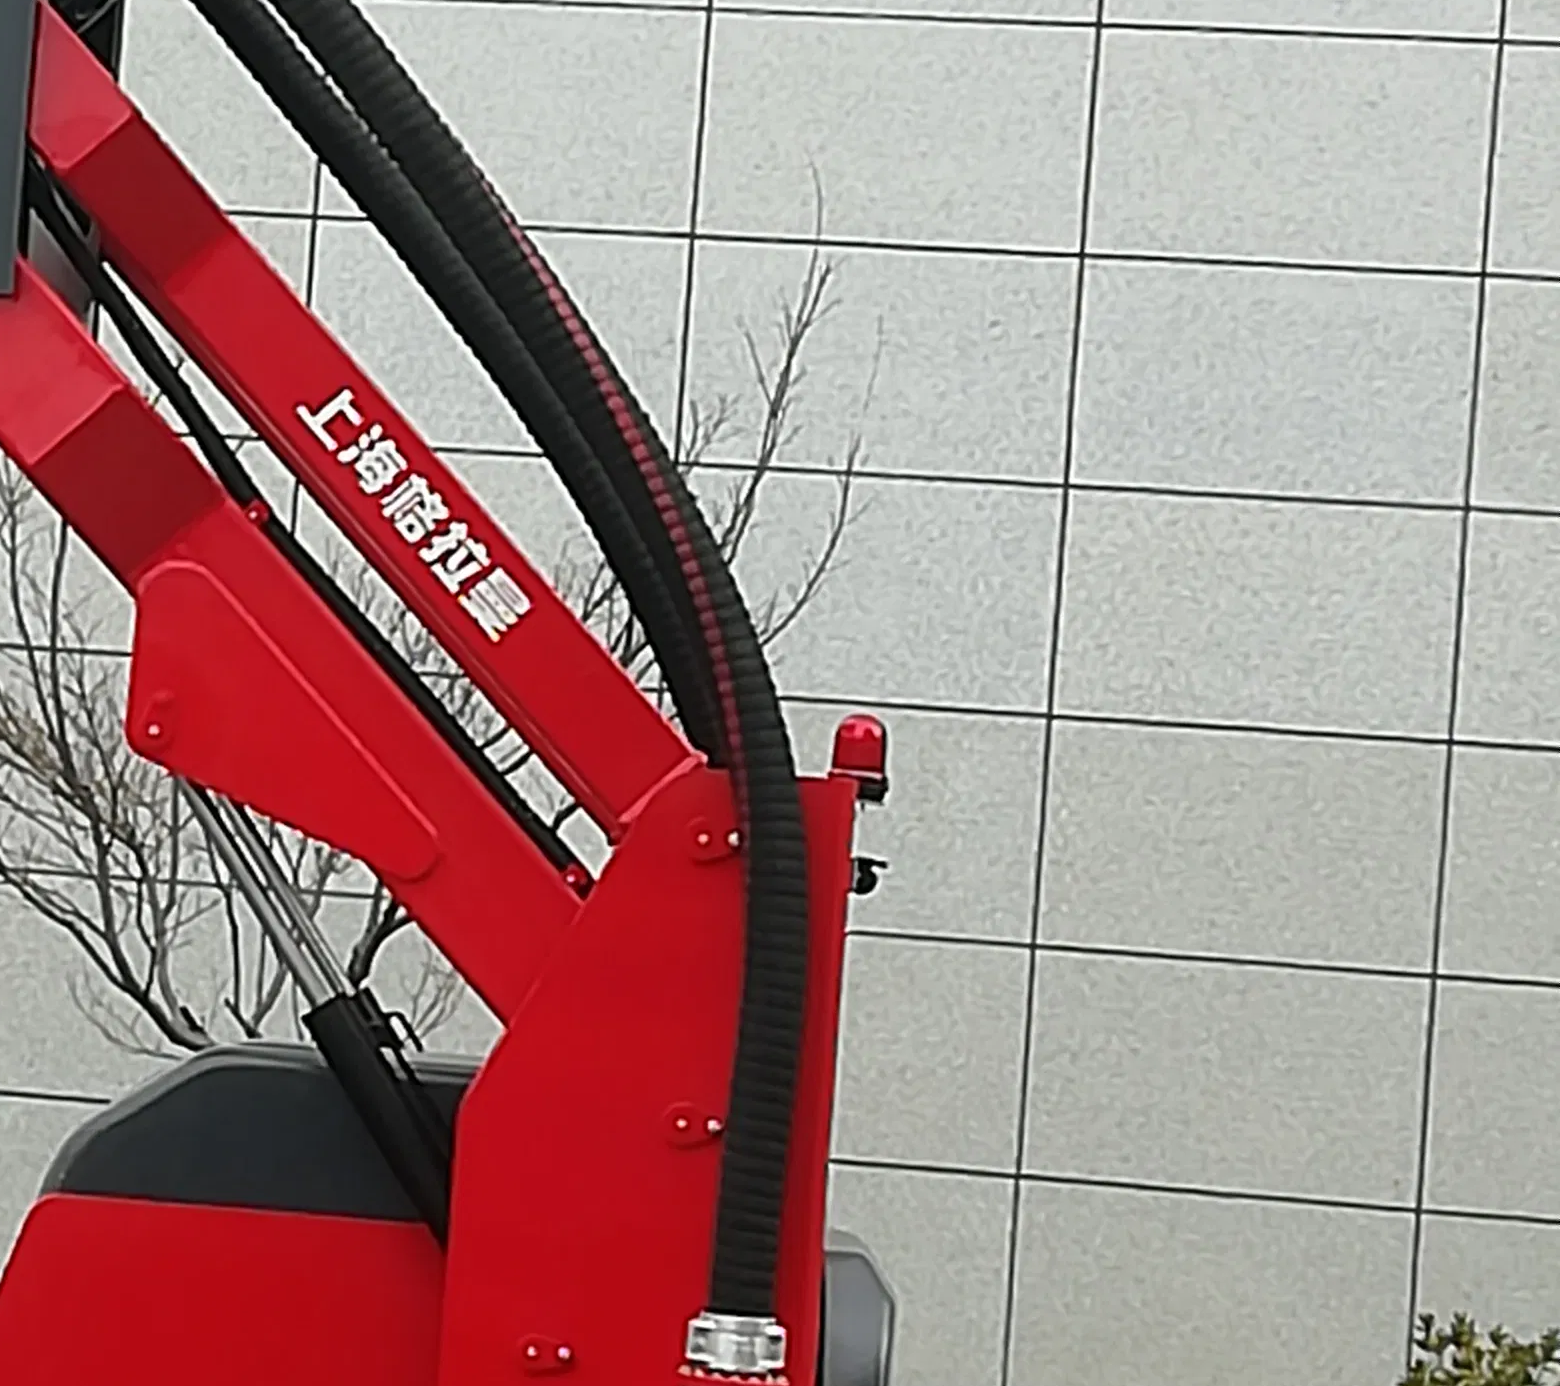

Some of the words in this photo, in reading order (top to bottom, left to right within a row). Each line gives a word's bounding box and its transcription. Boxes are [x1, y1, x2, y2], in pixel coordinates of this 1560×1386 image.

[296, 389, 531, 643] 上海格拉曼
